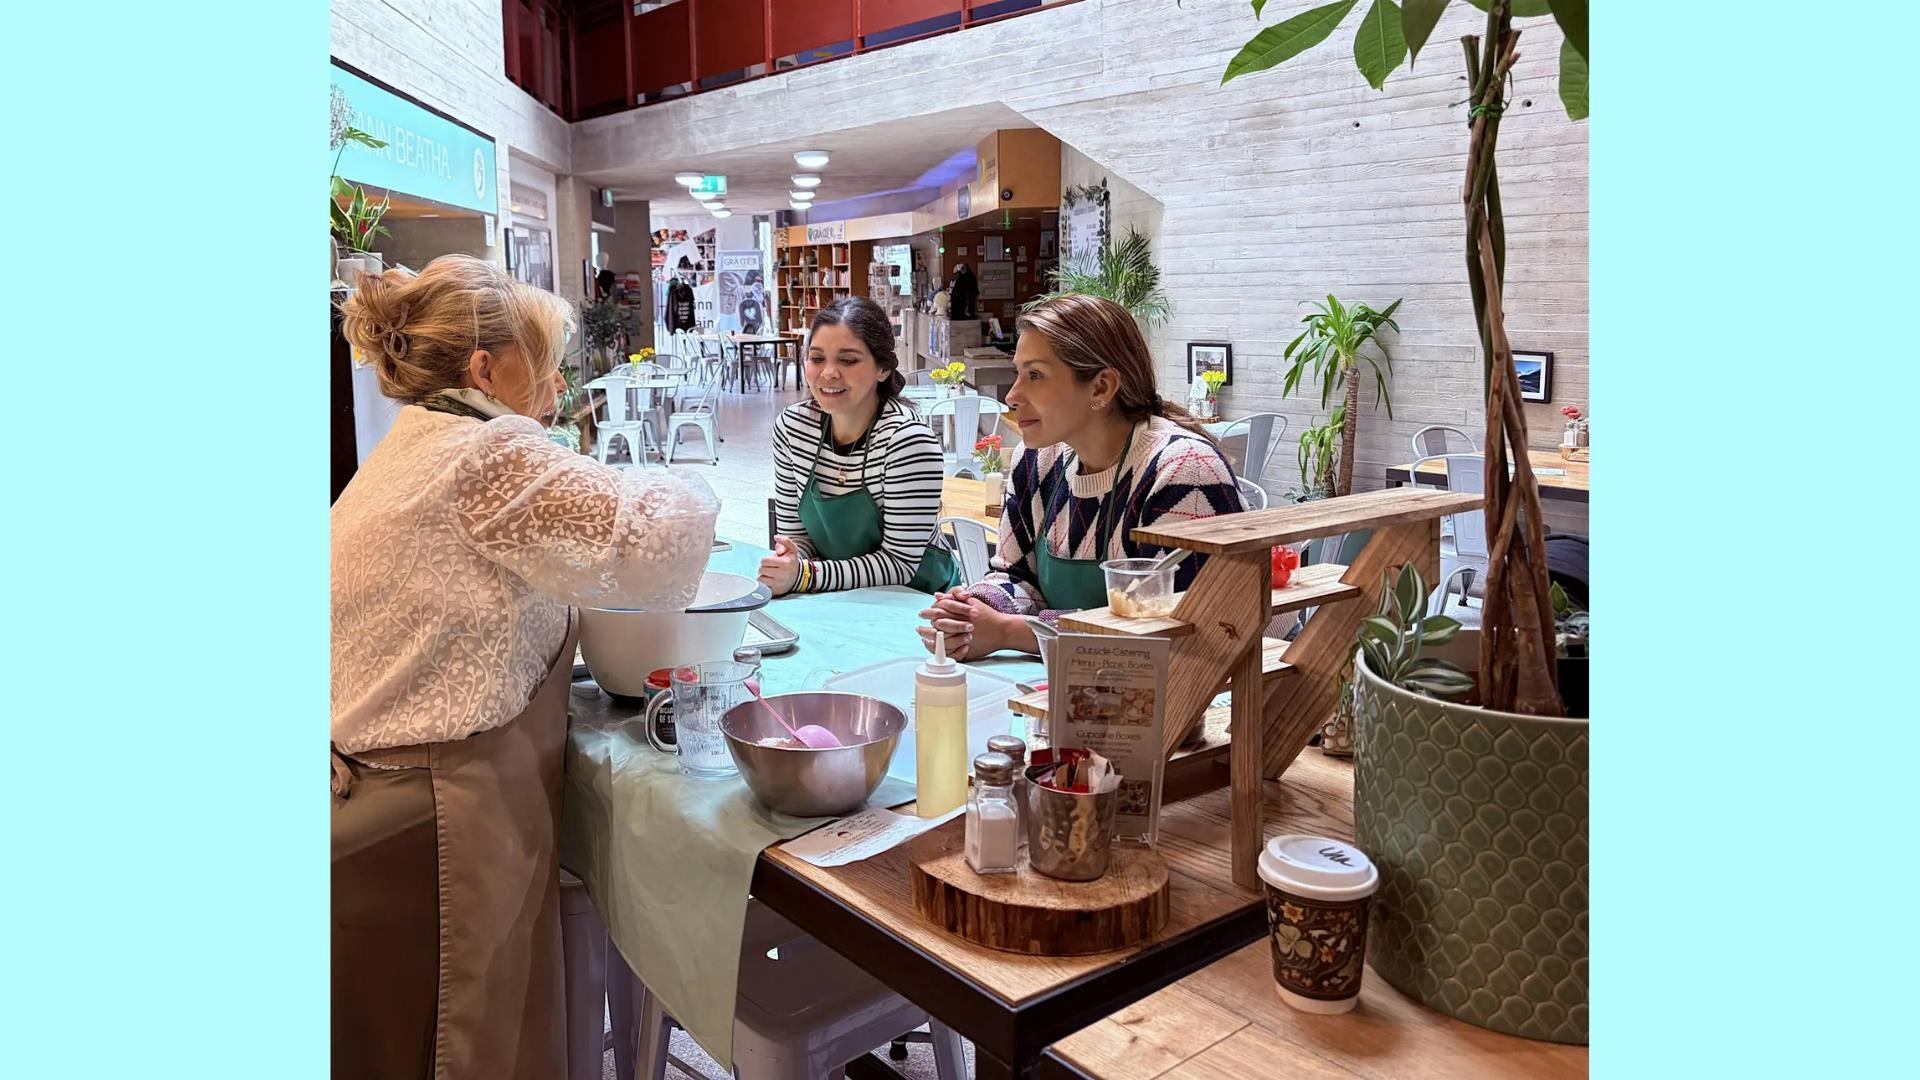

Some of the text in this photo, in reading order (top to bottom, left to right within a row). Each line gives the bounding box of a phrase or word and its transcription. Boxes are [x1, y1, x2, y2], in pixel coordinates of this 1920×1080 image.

[395, 127, 451, 178] BEATHA
[1075, 646, 1150, 660] Outside Catering
[1071, 658, 1096, 667] Menu
[1127, 660, 1154, 670] Boxes
[1115, 732, 1142, 740] Boxes
